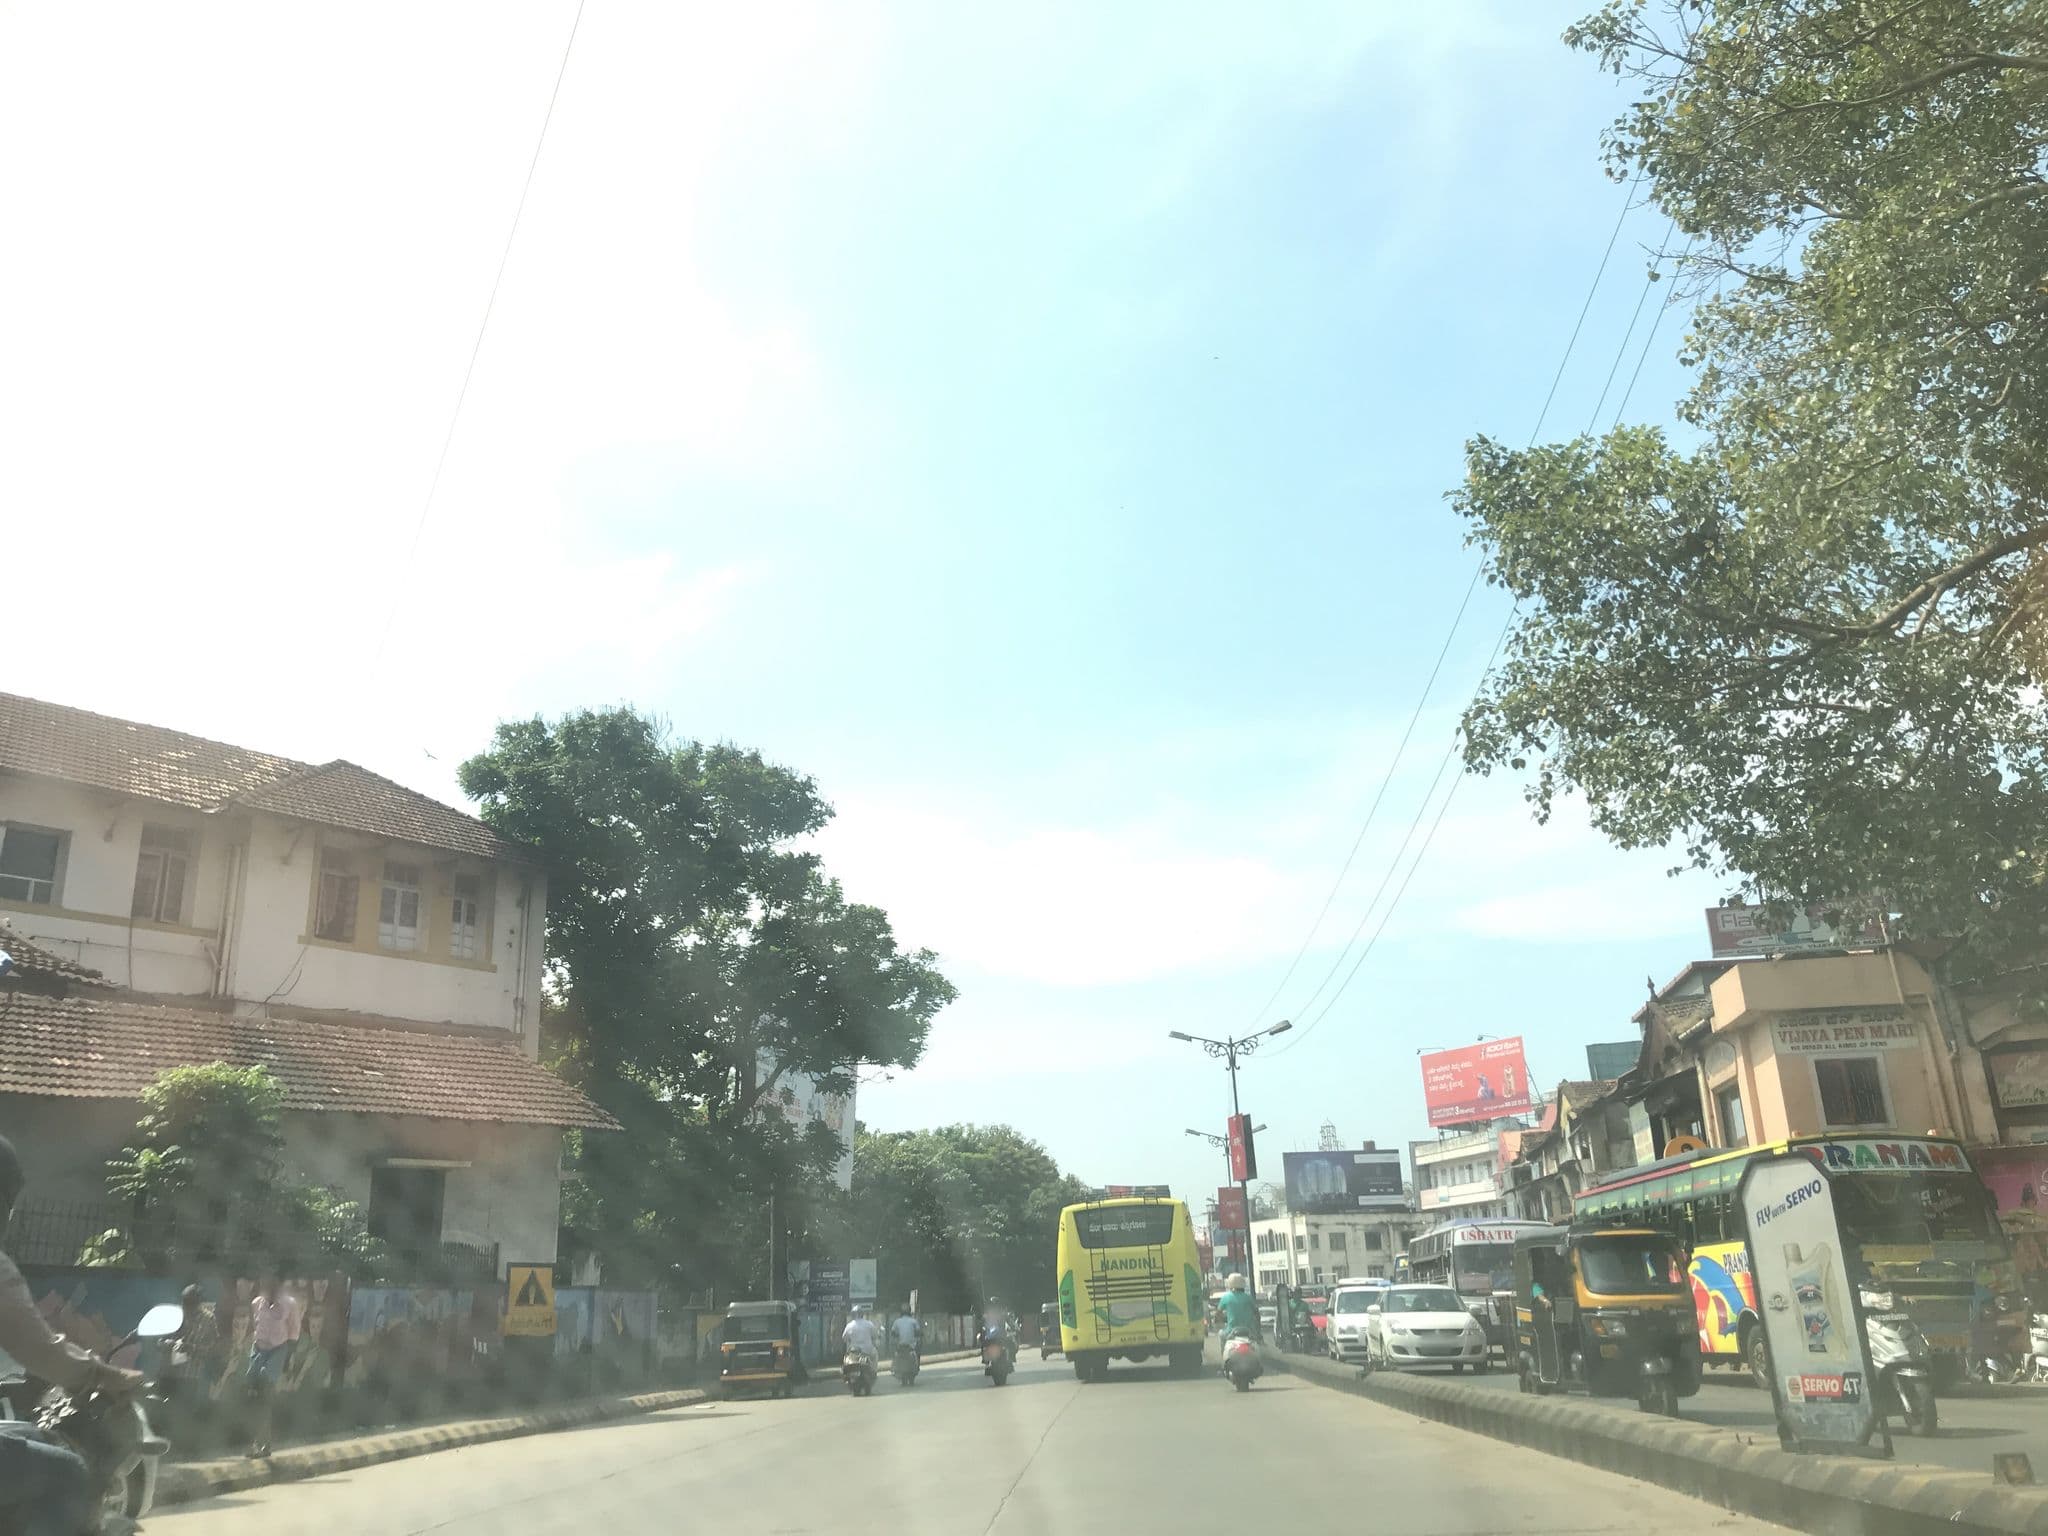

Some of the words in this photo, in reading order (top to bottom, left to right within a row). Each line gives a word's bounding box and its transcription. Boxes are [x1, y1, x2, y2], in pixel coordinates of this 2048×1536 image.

[1777, 1027, 1830, 1043] VIJAYA
[1832, 1025, 1866, 1041] PEN
[1755, 1204, 1771, 1227] FLY
[1771, 1203, 1787, 1218] WITH
[1785, 1179, 1822, 1209] SERVO
[1100, 1257, 1157, 1272] NANDINI
[1804, 1377, 1840, 1393] SERVO
[1843, 1376, 1859, 1395] 4T
